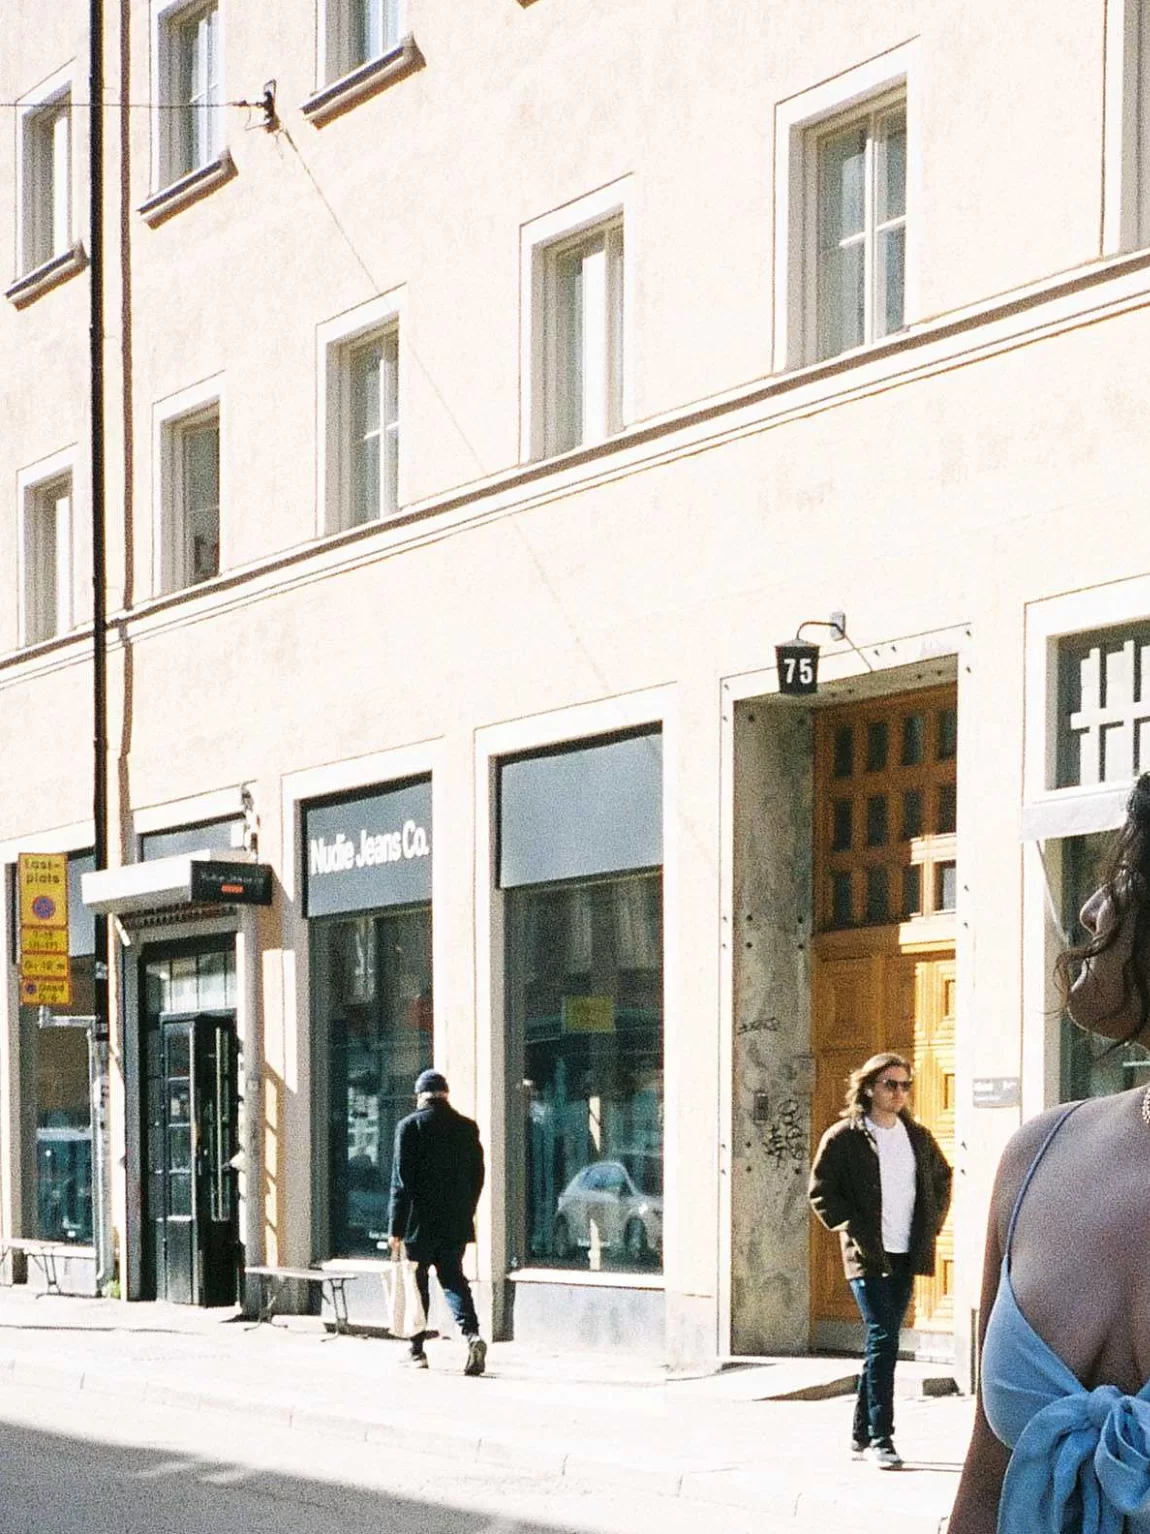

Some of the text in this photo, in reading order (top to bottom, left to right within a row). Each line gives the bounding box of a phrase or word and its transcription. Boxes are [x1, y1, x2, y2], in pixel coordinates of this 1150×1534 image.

[783, 658, 813, 684] 75
[310, 819, 430, 876] Nudie Jeans Co.
